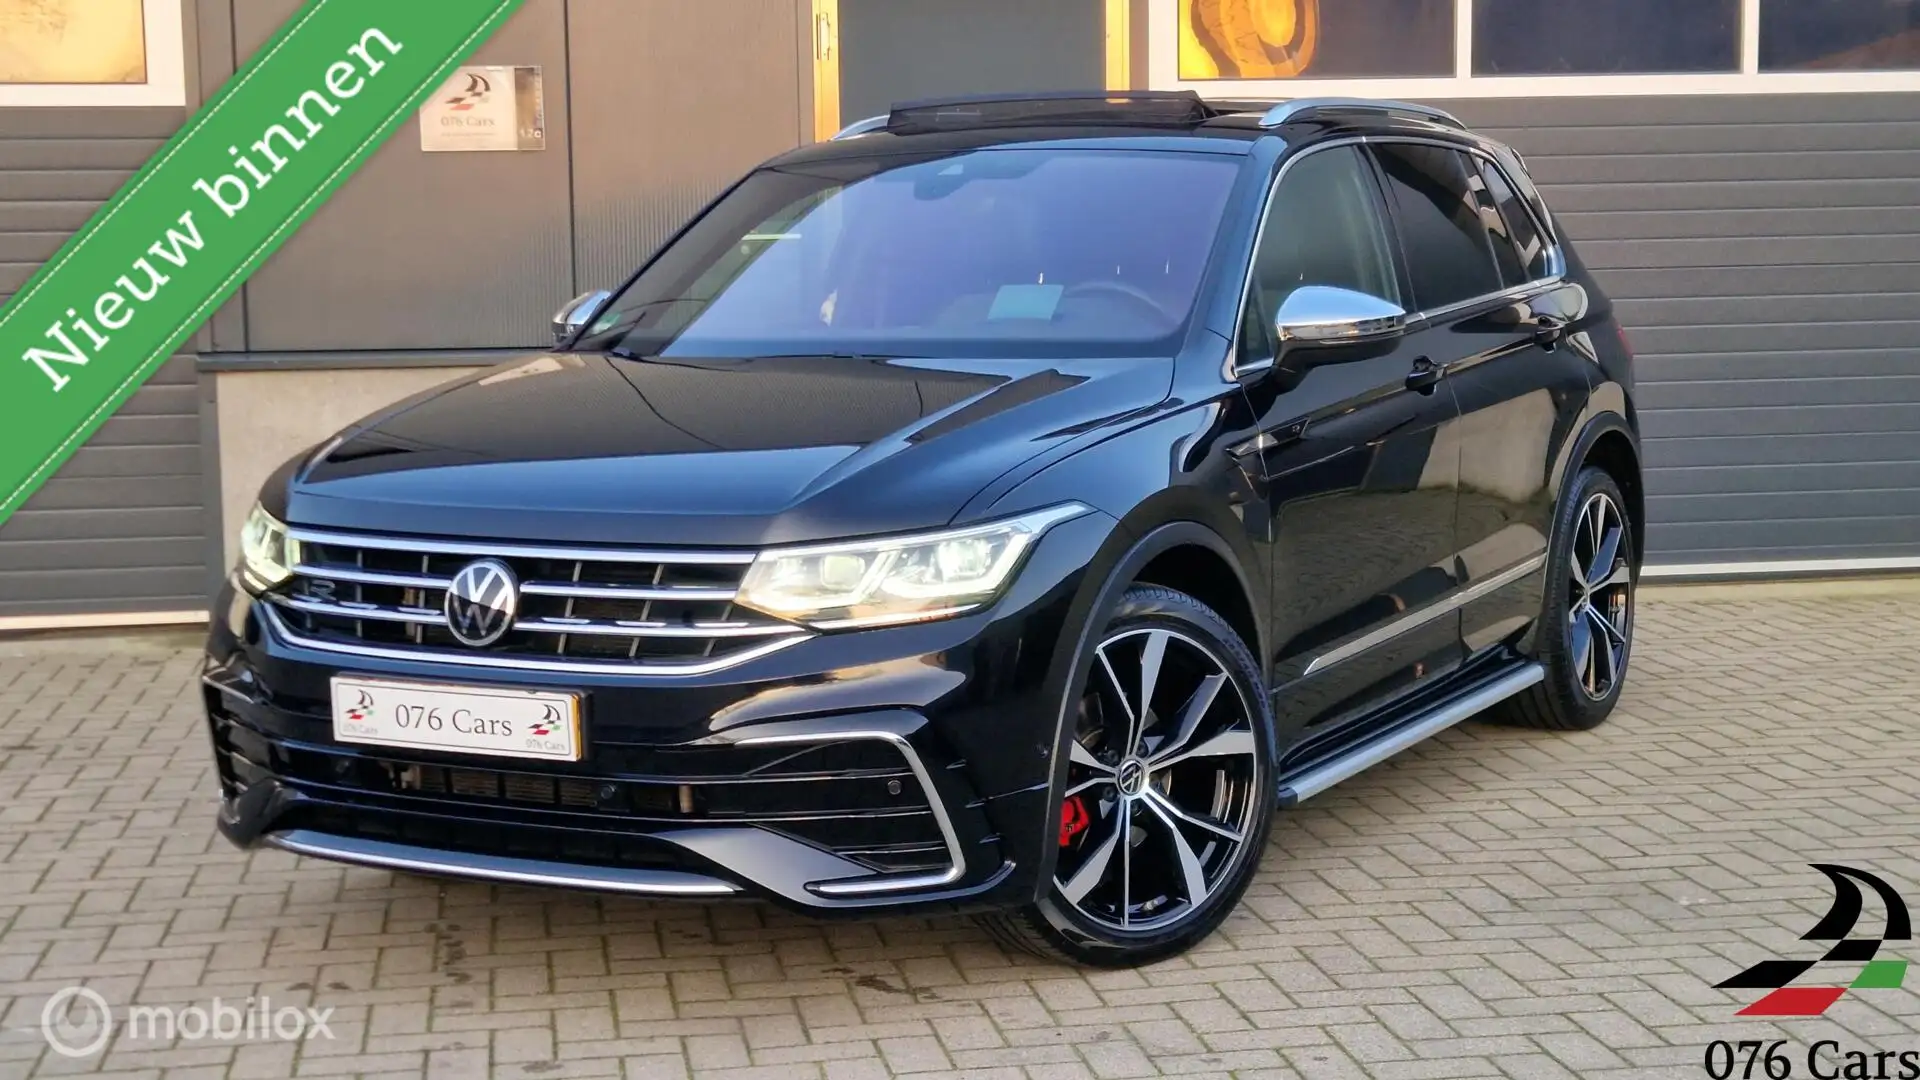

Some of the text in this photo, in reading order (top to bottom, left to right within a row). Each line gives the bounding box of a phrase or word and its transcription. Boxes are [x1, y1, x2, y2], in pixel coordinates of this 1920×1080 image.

[466, 115, 496, 128] Cars
[394, 703, 514, 737] 076 Cars
